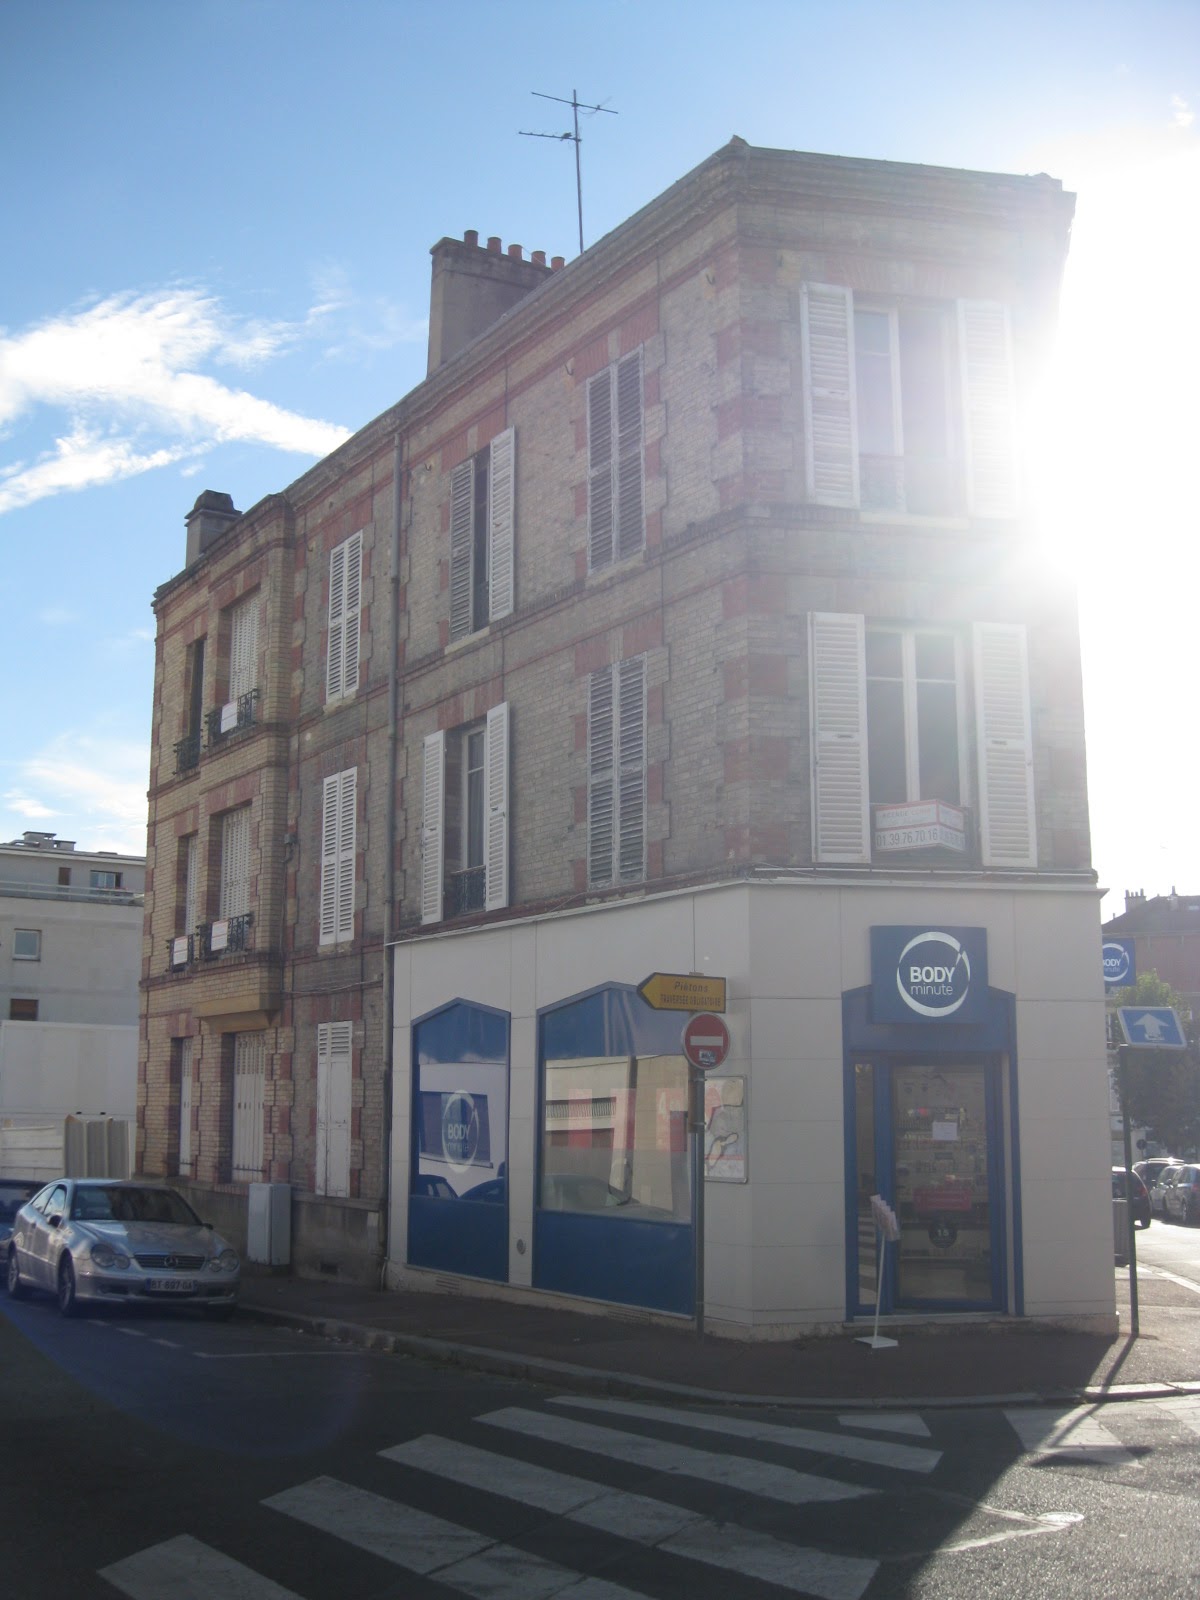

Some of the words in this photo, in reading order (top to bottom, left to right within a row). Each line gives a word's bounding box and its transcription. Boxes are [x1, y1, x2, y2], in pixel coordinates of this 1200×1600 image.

[910, 966, 955, 983] BODY
[911, 983, 953, 995] minute
[447, 1123, 471, 1140] BODY
